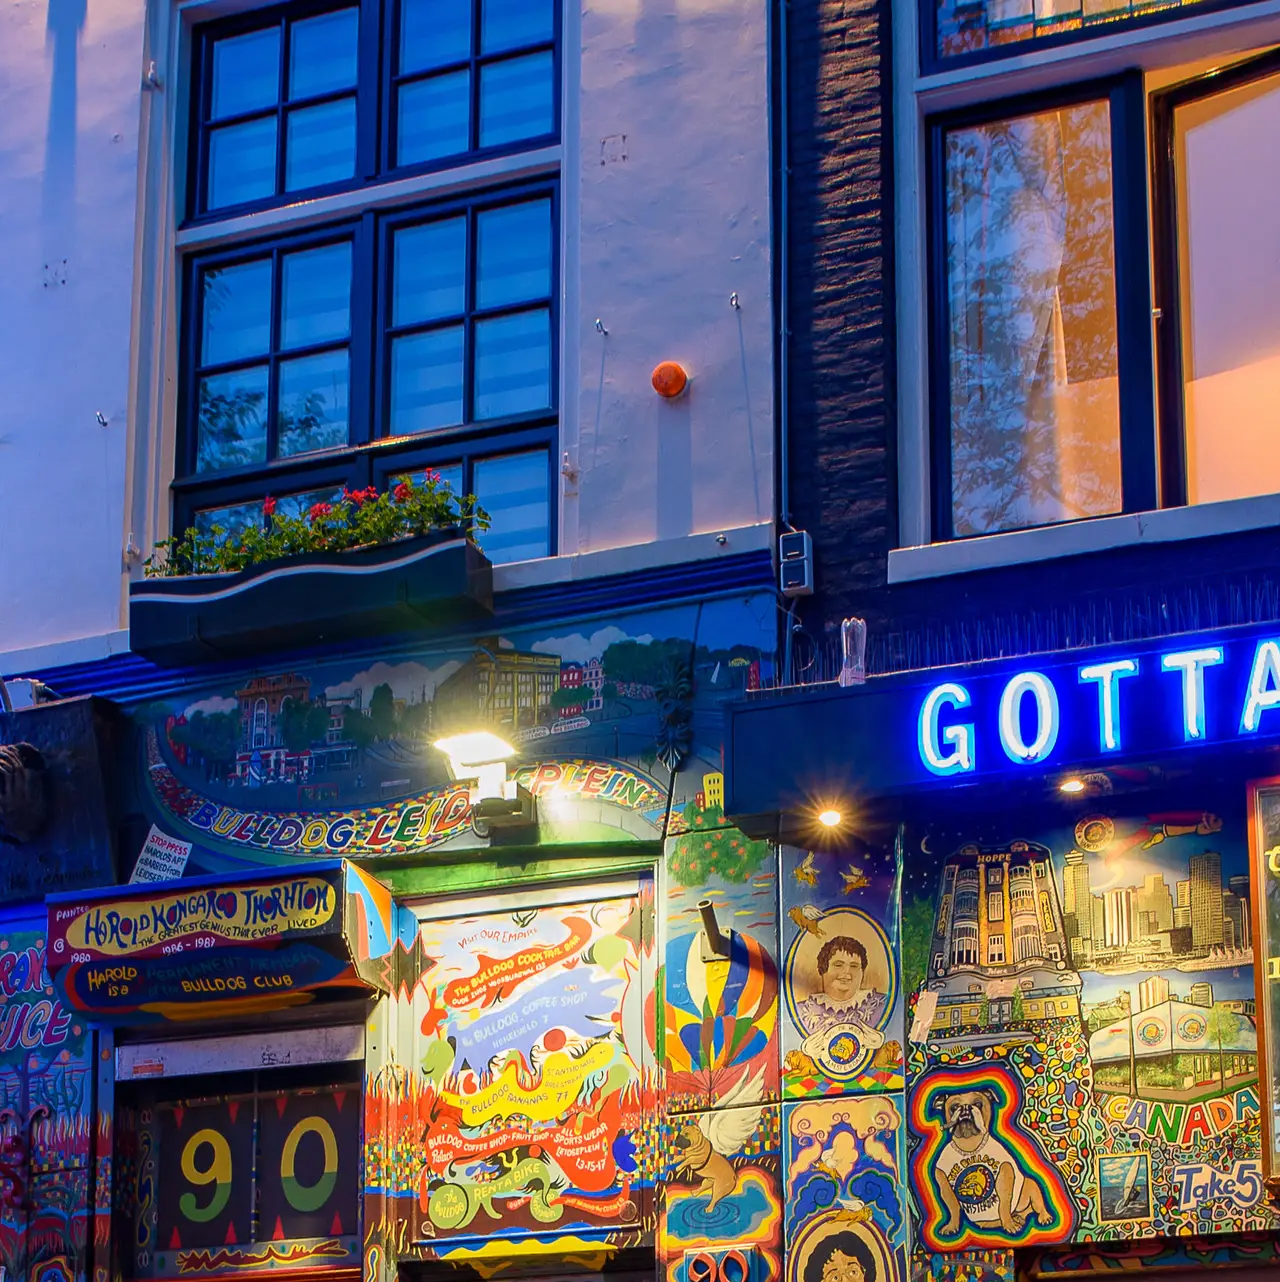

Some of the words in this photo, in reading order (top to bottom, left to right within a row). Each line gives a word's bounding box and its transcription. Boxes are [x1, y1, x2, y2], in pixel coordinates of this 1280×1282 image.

[191, 802, 356, 850] BULLDOG
[977, 853, 1012, 863] HOPPE
[138, 936, 156, 948] THE
[157, 920, 201, 942] GREATEST
[199, 919, 232, 936] GENIUS
[286, 917, 318, 931] LIVED
[480, 928, 501, 942] OUR
[70, 951, 92, 964] 1980
[161, 941, 184, 956] 1986
[194, 937, 217, 950] 1987
[87, 964, 138, 991] HAROLD
[453, 982, 471, 998] The
[470, 958, 515, 989] BULLDOG
[563, 934, 582, 953] BAR
[181, 975, 247, 993] BULLDOG
[253, 974, 294, 988] CLUB
[520, 995, 559, 1017] COFFEE
[558, 990, 590, 1009] SHOP
[470, 1083, 510, 1115] BULLDOG
[555, 1090, 569, 1103] 77
[1106, 1090, 1261, 1146] CANADA
[427, 1132, 463, 1150] BULLDOG
[463, 1141, 489, 1153] COFFEE
[510, 1131, 532, 1143] FRUIT
[552, 1132, 583, 1146] SPORTS
[582, 1121, 609, 1142] WEAR
[560, 1127, 575, 1138] ALL
[472, 1184, 502, 1203] RENT
[500, 1177, 513, 1191] A
[512, 1161, 541, 1183] BIKE
[947, 1162, 962, 1182] THE
